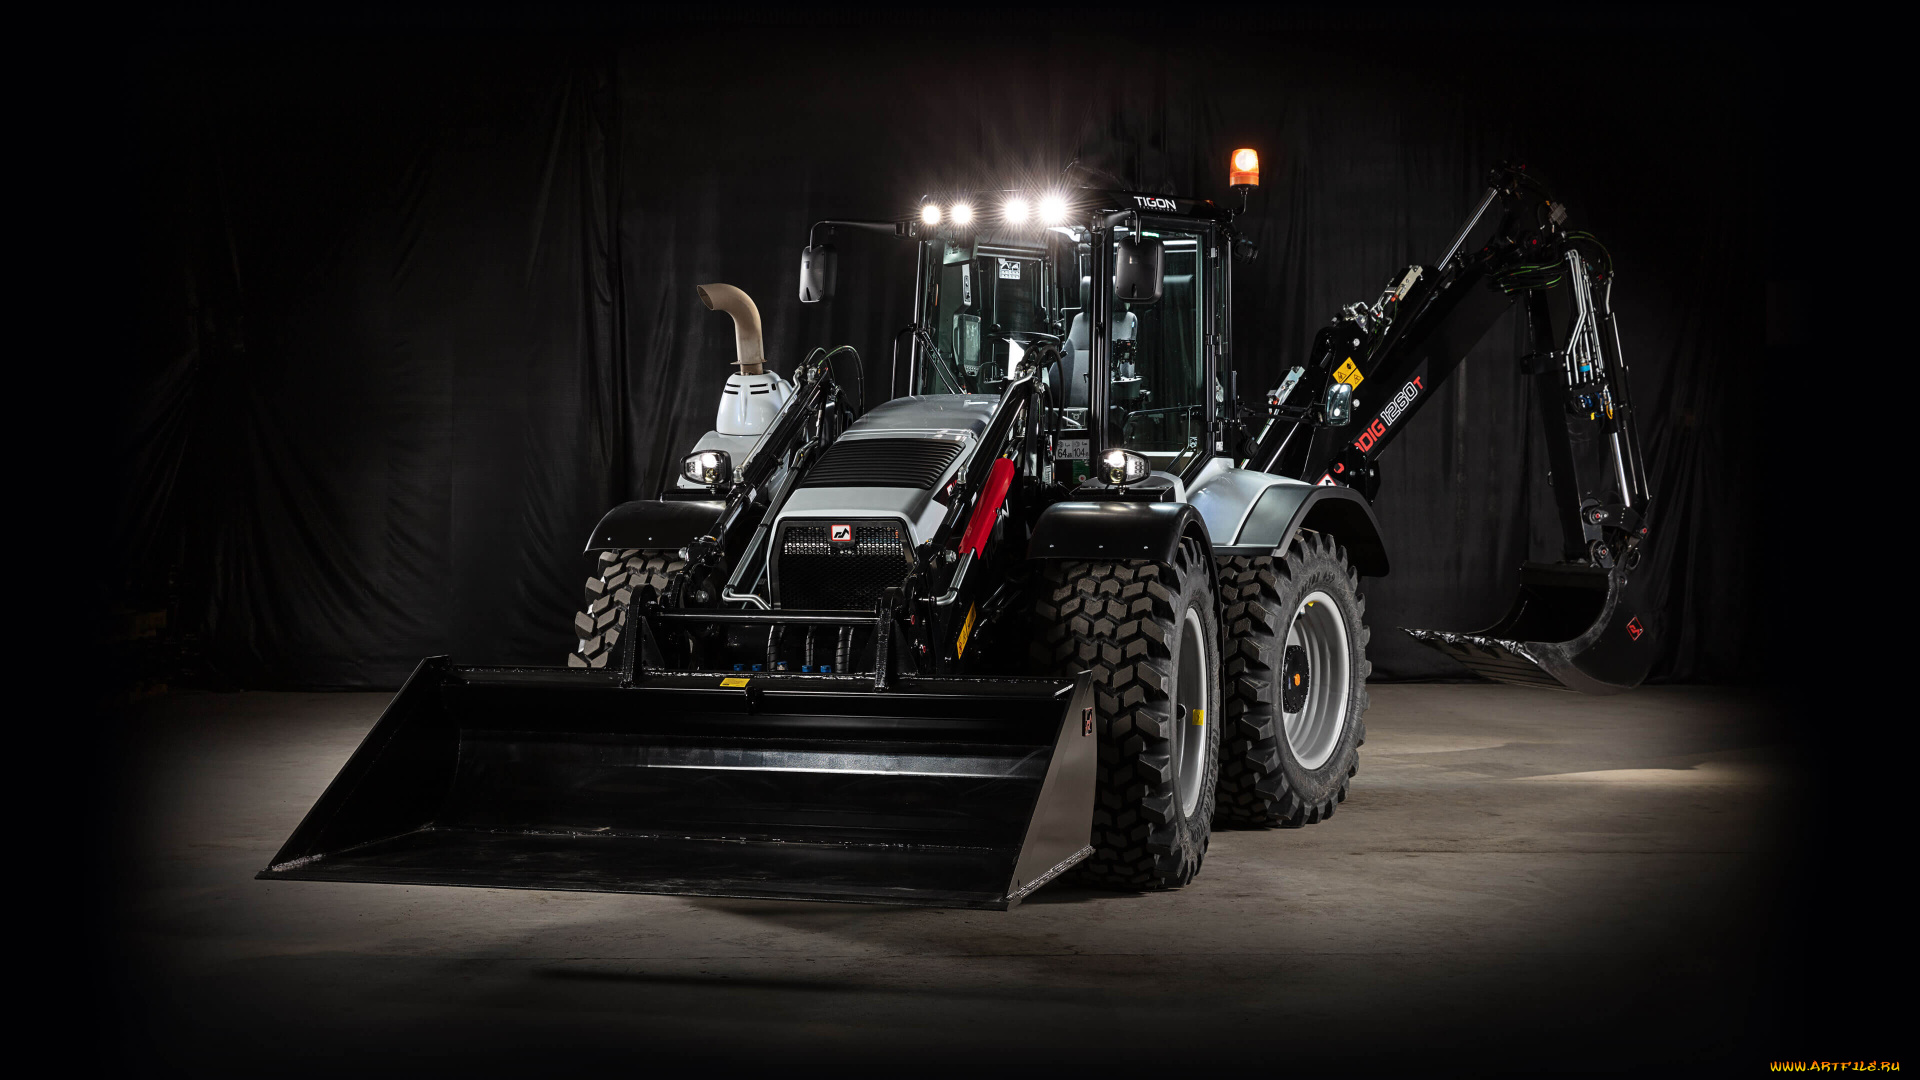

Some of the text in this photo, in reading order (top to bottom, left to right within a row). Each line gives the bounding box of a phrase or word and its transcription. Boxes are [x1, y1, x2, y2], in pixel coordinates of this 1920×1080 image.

[1133, 196, 1176, 209] TIGON
[1058, 449, 1067, 458] 64
[1073, 448, 1085, 457] 104
